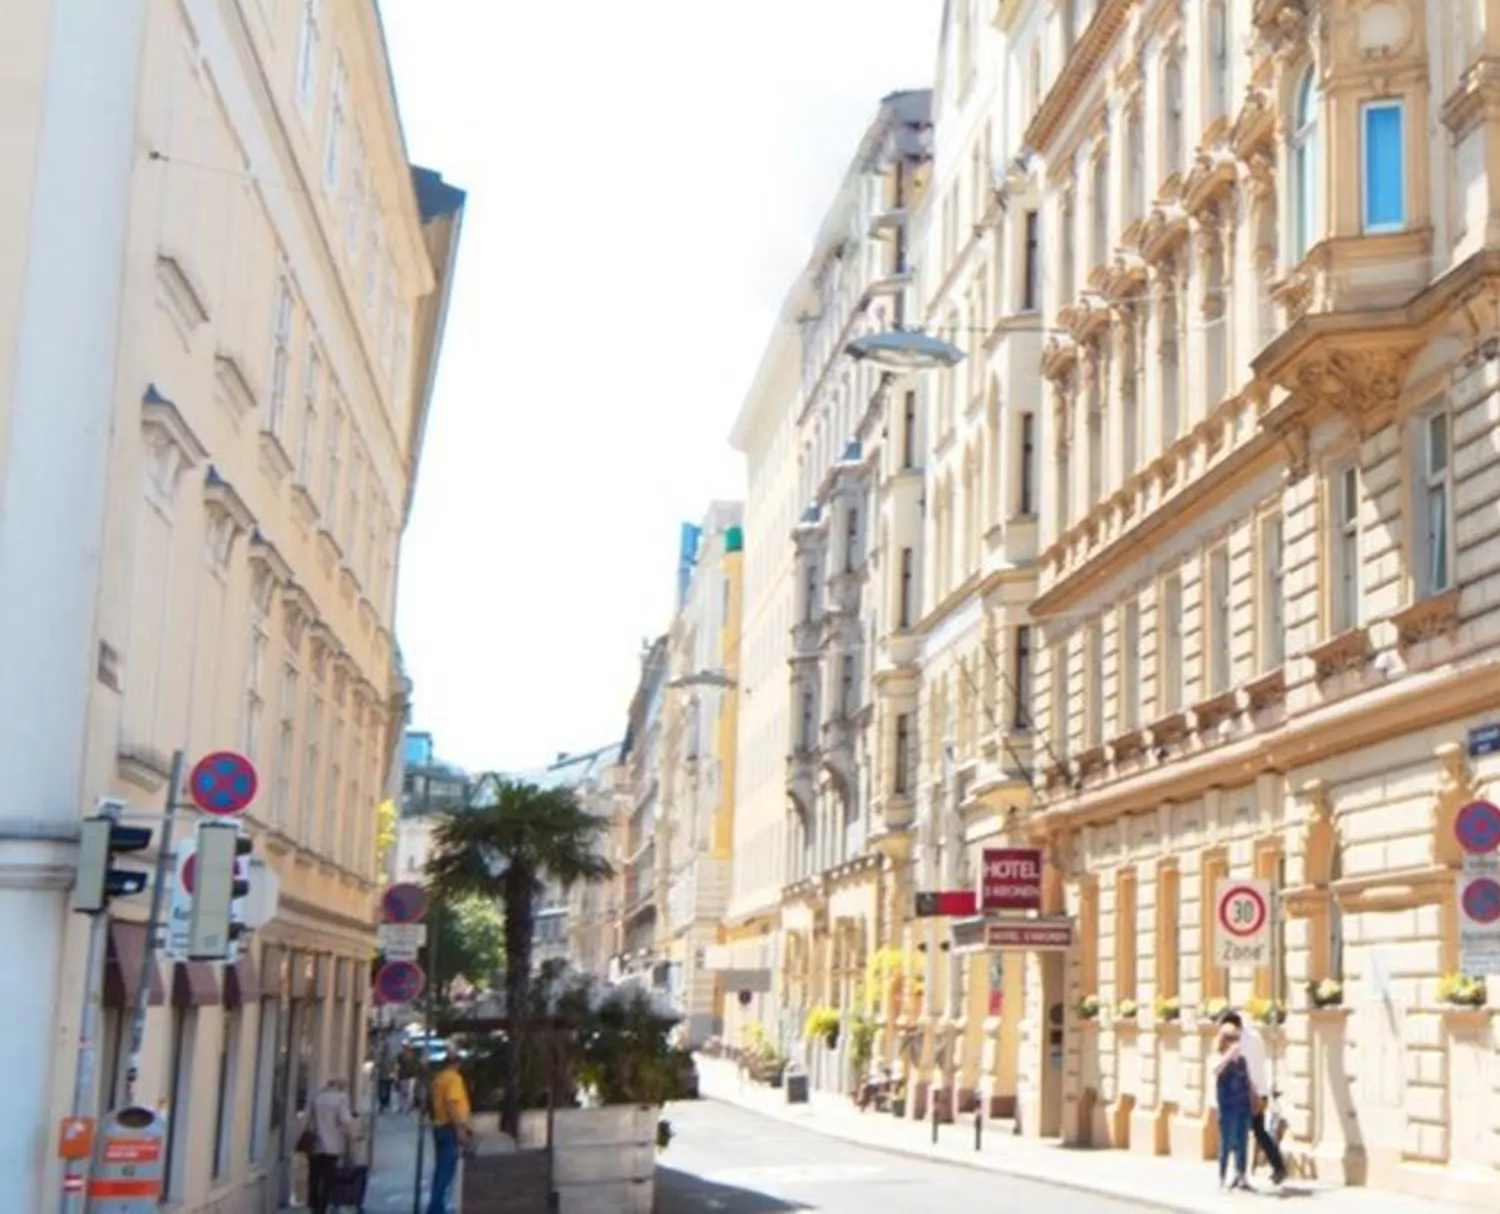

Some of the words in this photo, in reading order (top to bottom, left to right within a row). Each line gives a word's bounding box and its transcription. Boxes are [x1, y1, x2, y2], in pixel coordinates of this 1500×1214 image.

[982, 859, 1040, 879] HOTEL
[1232, 899, 1255, 924] 30
[1222, 940, 1263, 961] Zone
